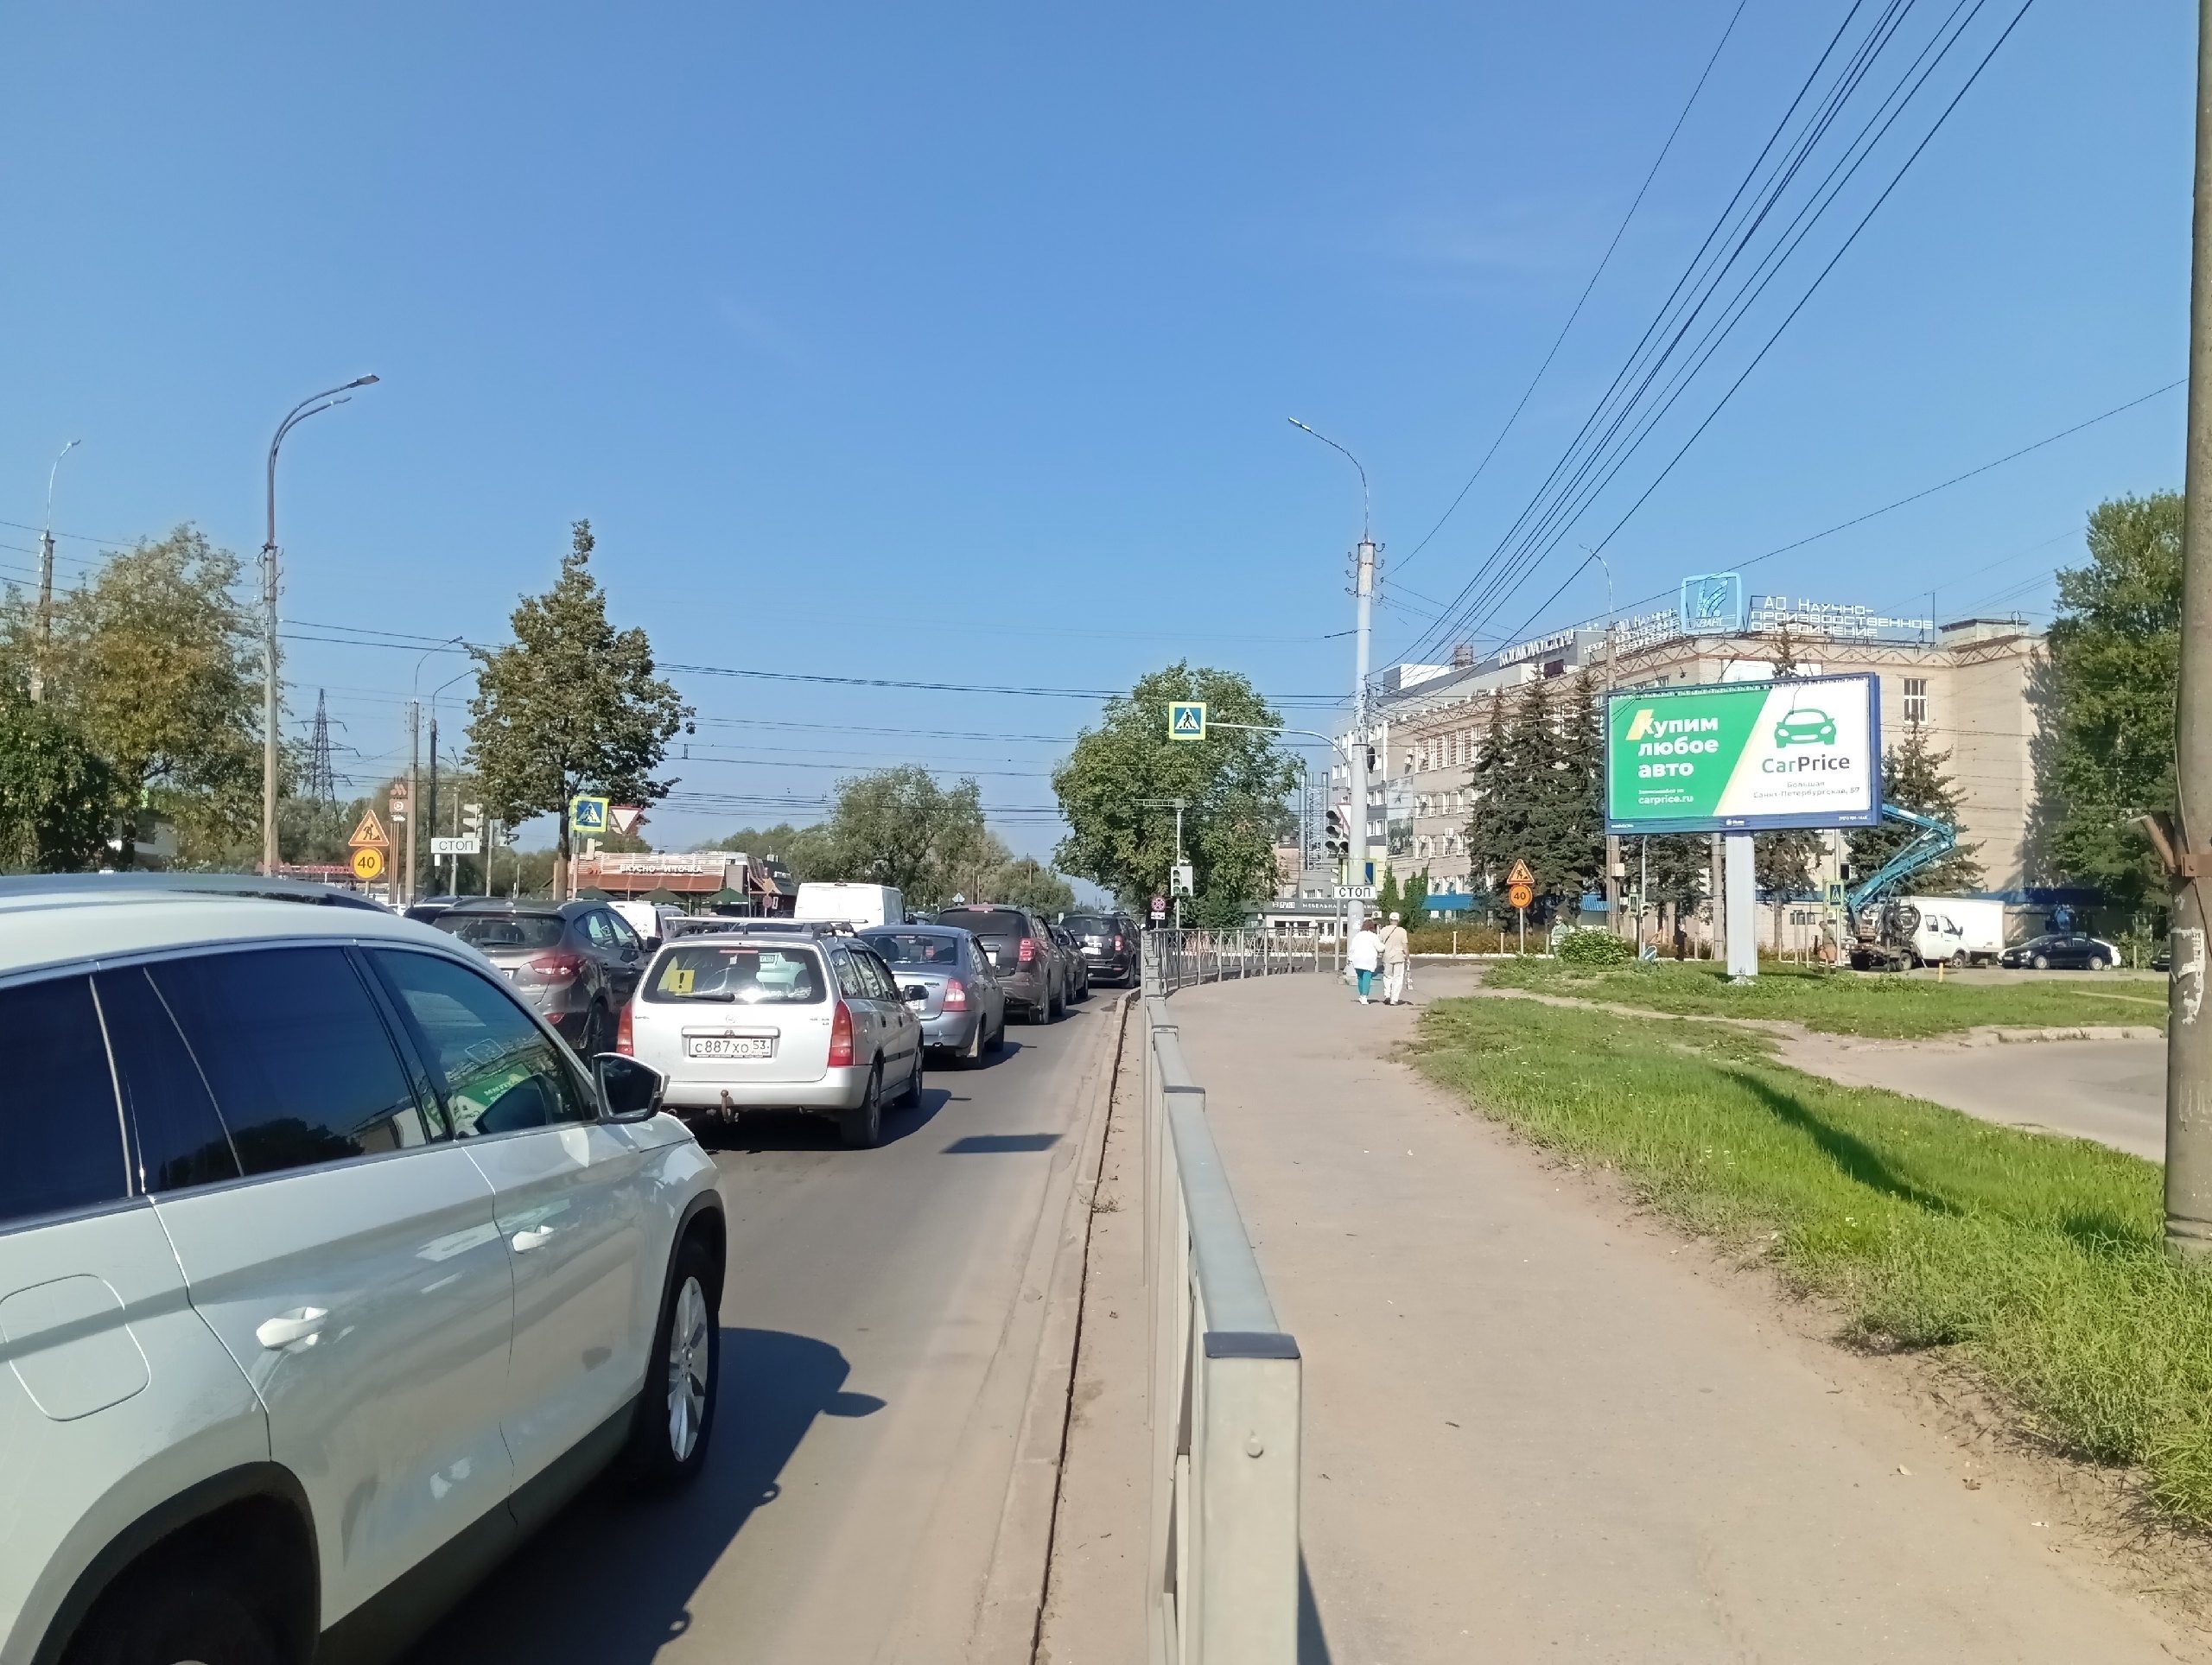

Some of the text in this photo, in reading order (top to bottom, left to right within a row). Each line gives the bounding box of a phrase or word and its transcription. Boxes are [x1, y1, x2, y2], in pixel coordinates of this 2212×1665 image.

[1764, 596, 1787, 610] АО
[1751, 611, 1934, 630] ПРОИЗВОДСТВЕННОЕ
[1639, 718, 1718, 738] Купим
[1638, 736, 1719, 756] любое
[1638, 762, 1694, 778] авто
[1762, 753, 1850, 773] CarPrice
[1638, 795, 1694, 805] carprice.ru
[439, 841, 474, 851] СТОП
[358, 856, 375, 869] 40
[1339, 887, 1370, 897] СТОП
[1514, 892, 1526, 900] 40
